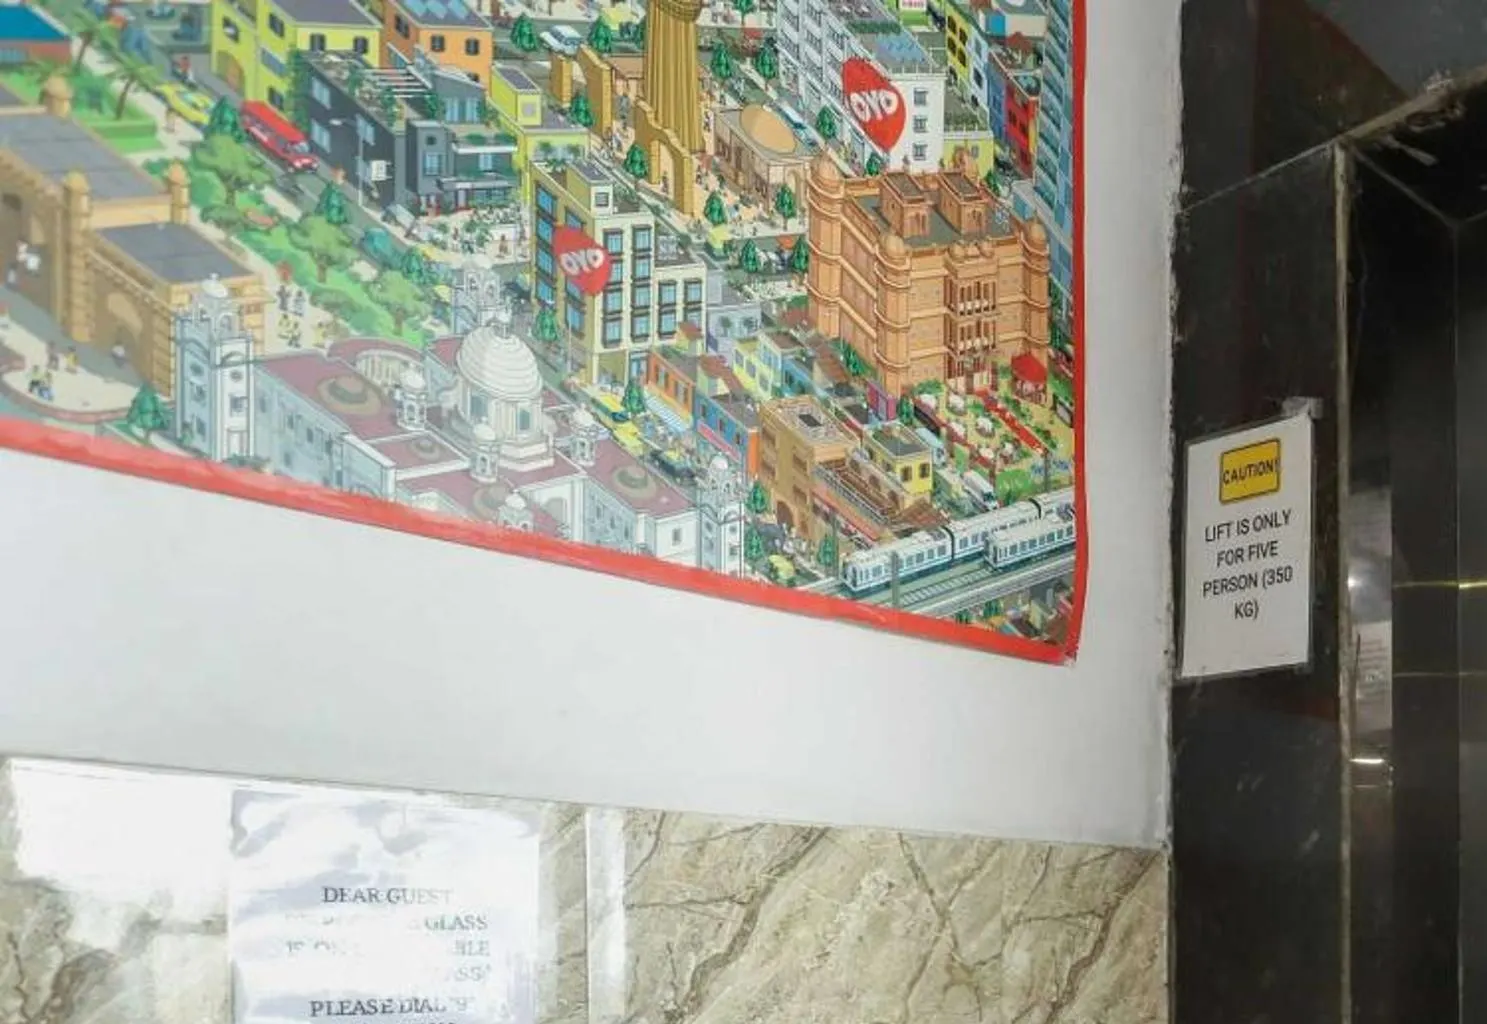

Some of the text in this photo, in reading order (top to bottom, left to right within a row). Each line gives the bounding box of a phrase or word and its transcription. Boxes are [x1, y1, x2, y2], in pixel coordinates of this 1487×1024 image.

[850, 88, 898, 122] OYO
[560, 248, 604, 276] OYO
[1204, 508, 1292, 542] LIFT IS ONLY
[1216, 540, 1279, 568] FOR FIVE
[1202, 565, 1294, 598] PERSON (350
[1234, 598, 1260, 620] KG)
[322, 886, 455, 906] DEAR GUEST
[308, 997, 395, 1018] PLEASE
